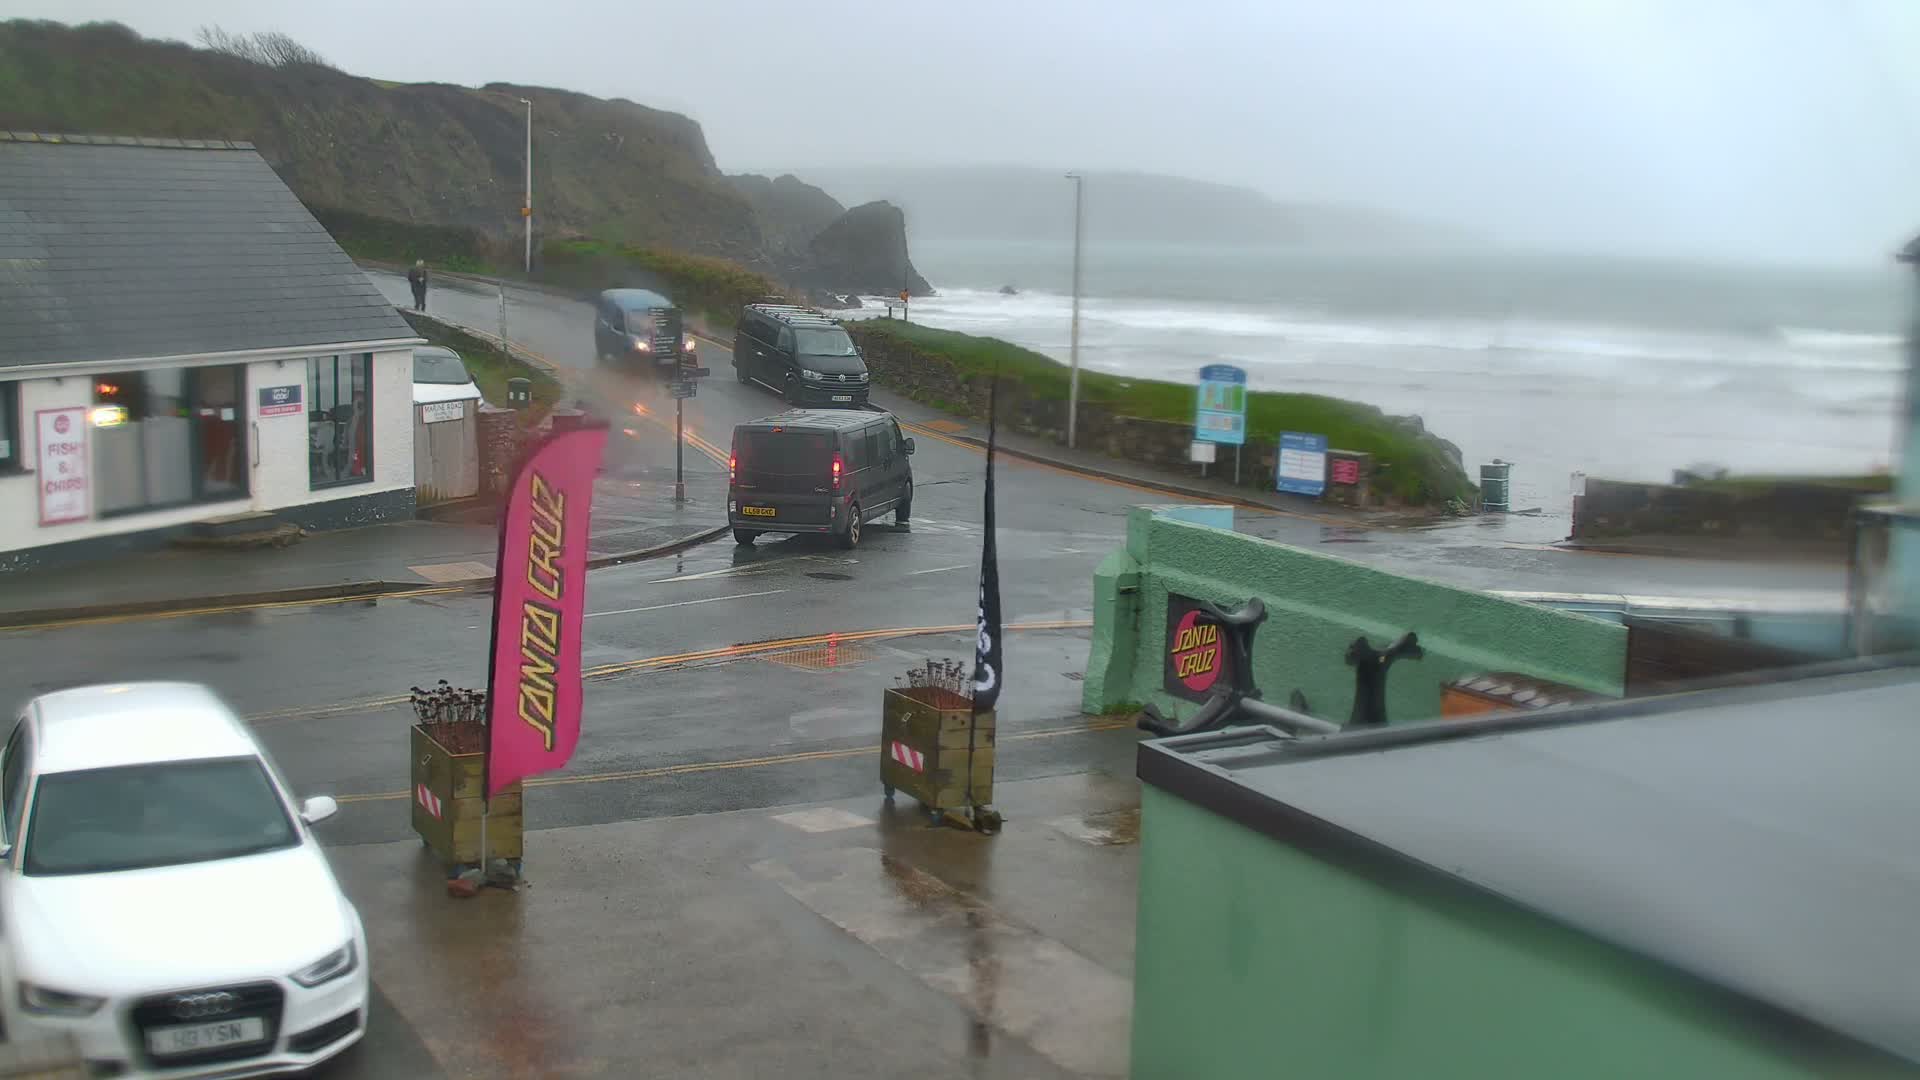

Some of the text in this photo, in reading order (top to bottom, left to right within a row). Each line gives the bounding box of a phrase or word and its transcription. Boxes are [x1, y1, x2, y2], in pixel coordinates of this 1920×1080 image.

[424, 402, 463, 412] MARINE ROAD
[47, 442, 79, 457] FISH
[46, 477, 84, 495] CHIPS
[518, 470, 568, 753] SANTA CRUZ
[1171, 624, 1217, 654] SANTA
[1178, 648, 1217, 679] CRUZ
